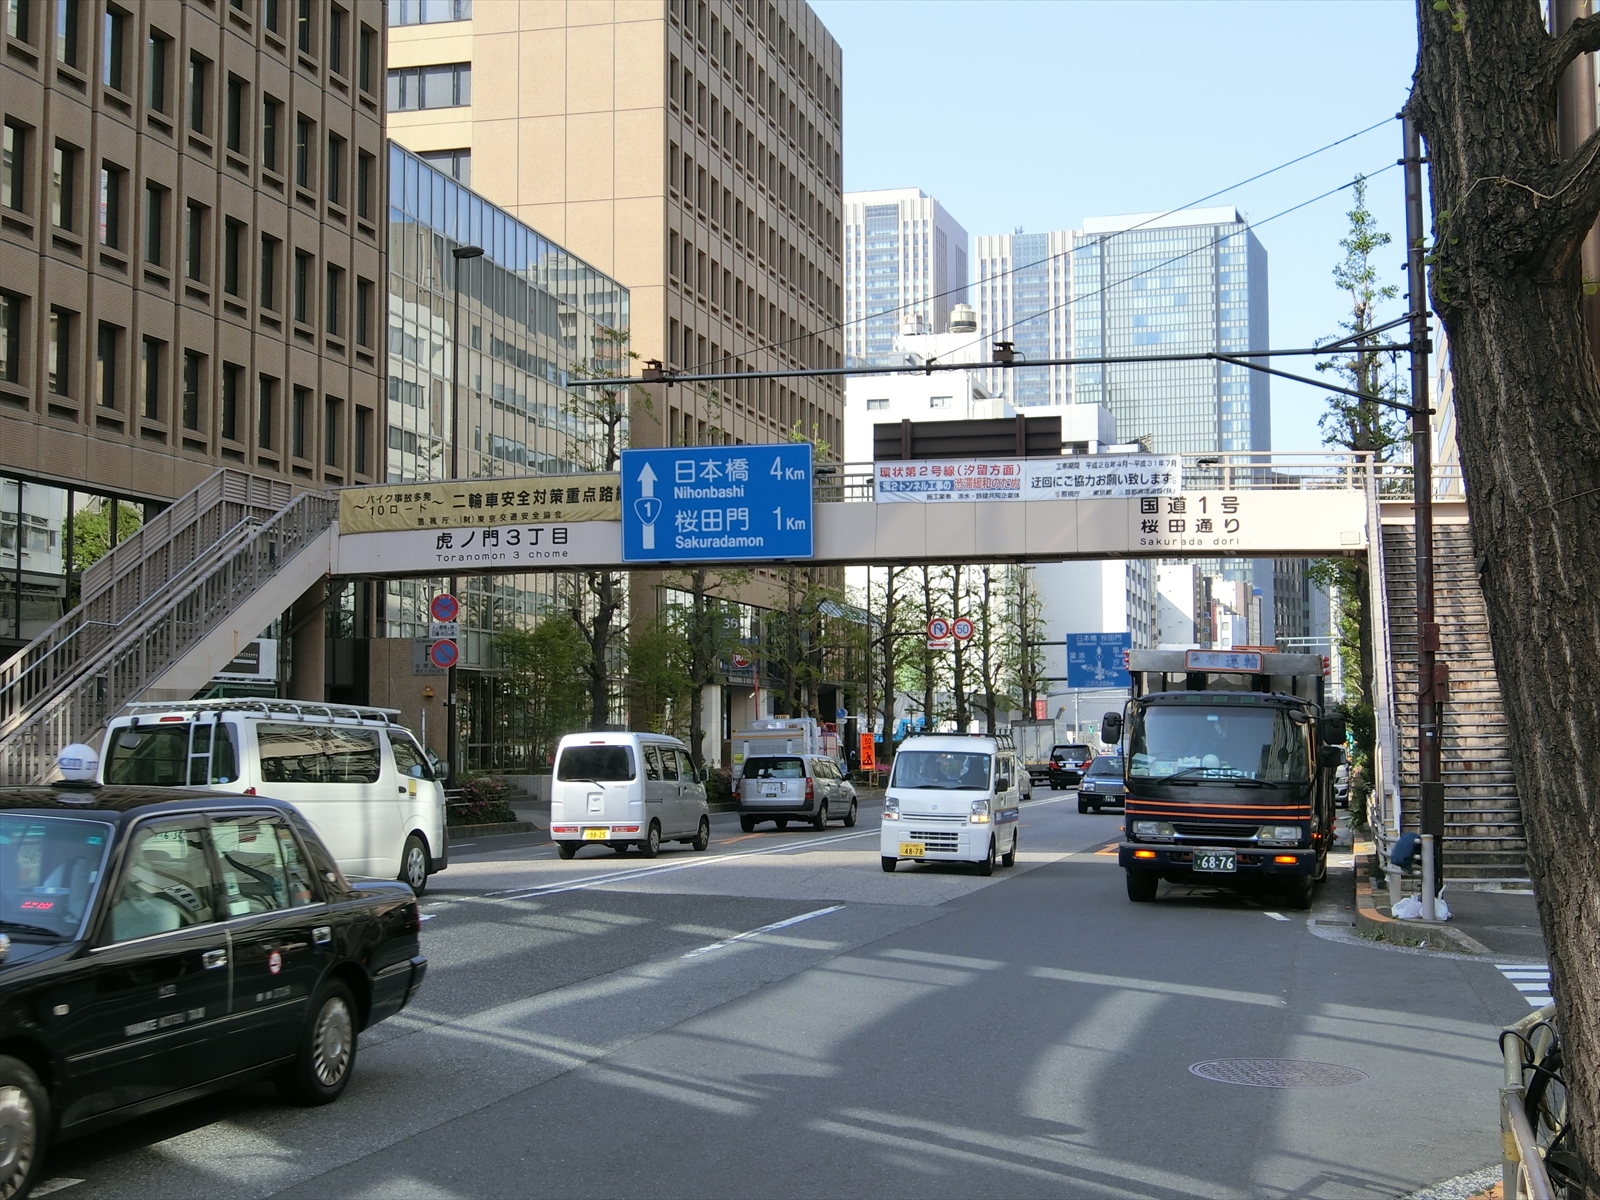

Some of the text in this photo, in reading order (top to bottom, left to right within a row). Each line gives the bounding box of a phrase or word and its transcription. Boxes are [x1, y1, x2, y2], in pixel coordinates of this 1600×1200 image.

[675, 458, 749, 483] 日本橋
[674, 485, 744, 499] Nihonbashi
[644, 501, 651, 518] 1
[1140, 496, 1240, 514] 国道1号
[674, 507, 749, 533] 桜田門
[1140, 518, 1240, 533] 桜田通り
[436, 527, 568, 550] 虎ノ門3丁目
[675, 534, 764, 550] Sakuradamon
[1140, 537, 1239, 546] Sakurada dori
[436, 550, 569, 562] Toranomon 3 chome
[722, 618, 739, 630] 36
[956, 624, 970, 635] 50
[865, 737, 871, 745] 50
[1201, 856, 1234, 870] 68-76
